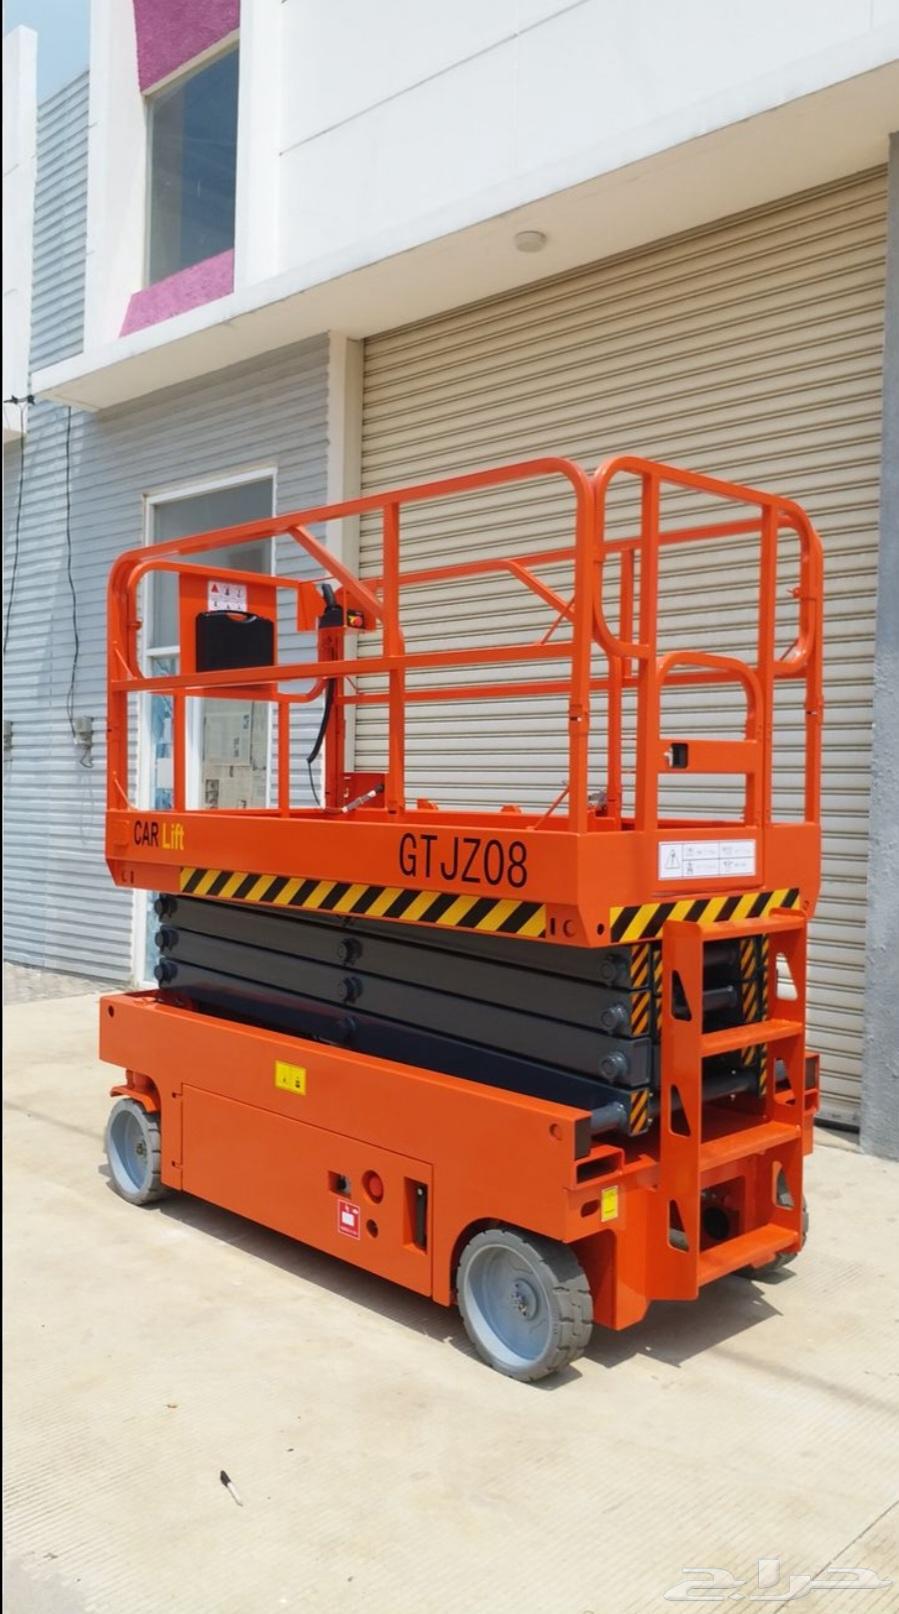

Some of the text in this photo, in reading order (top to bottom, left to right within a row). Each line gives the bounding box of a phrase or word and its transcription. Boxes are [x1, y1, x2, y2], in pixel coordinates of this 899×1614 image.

[133, 820, 185, 850] CAR Lift
[399, 832, 528, 888] GTJZ08
